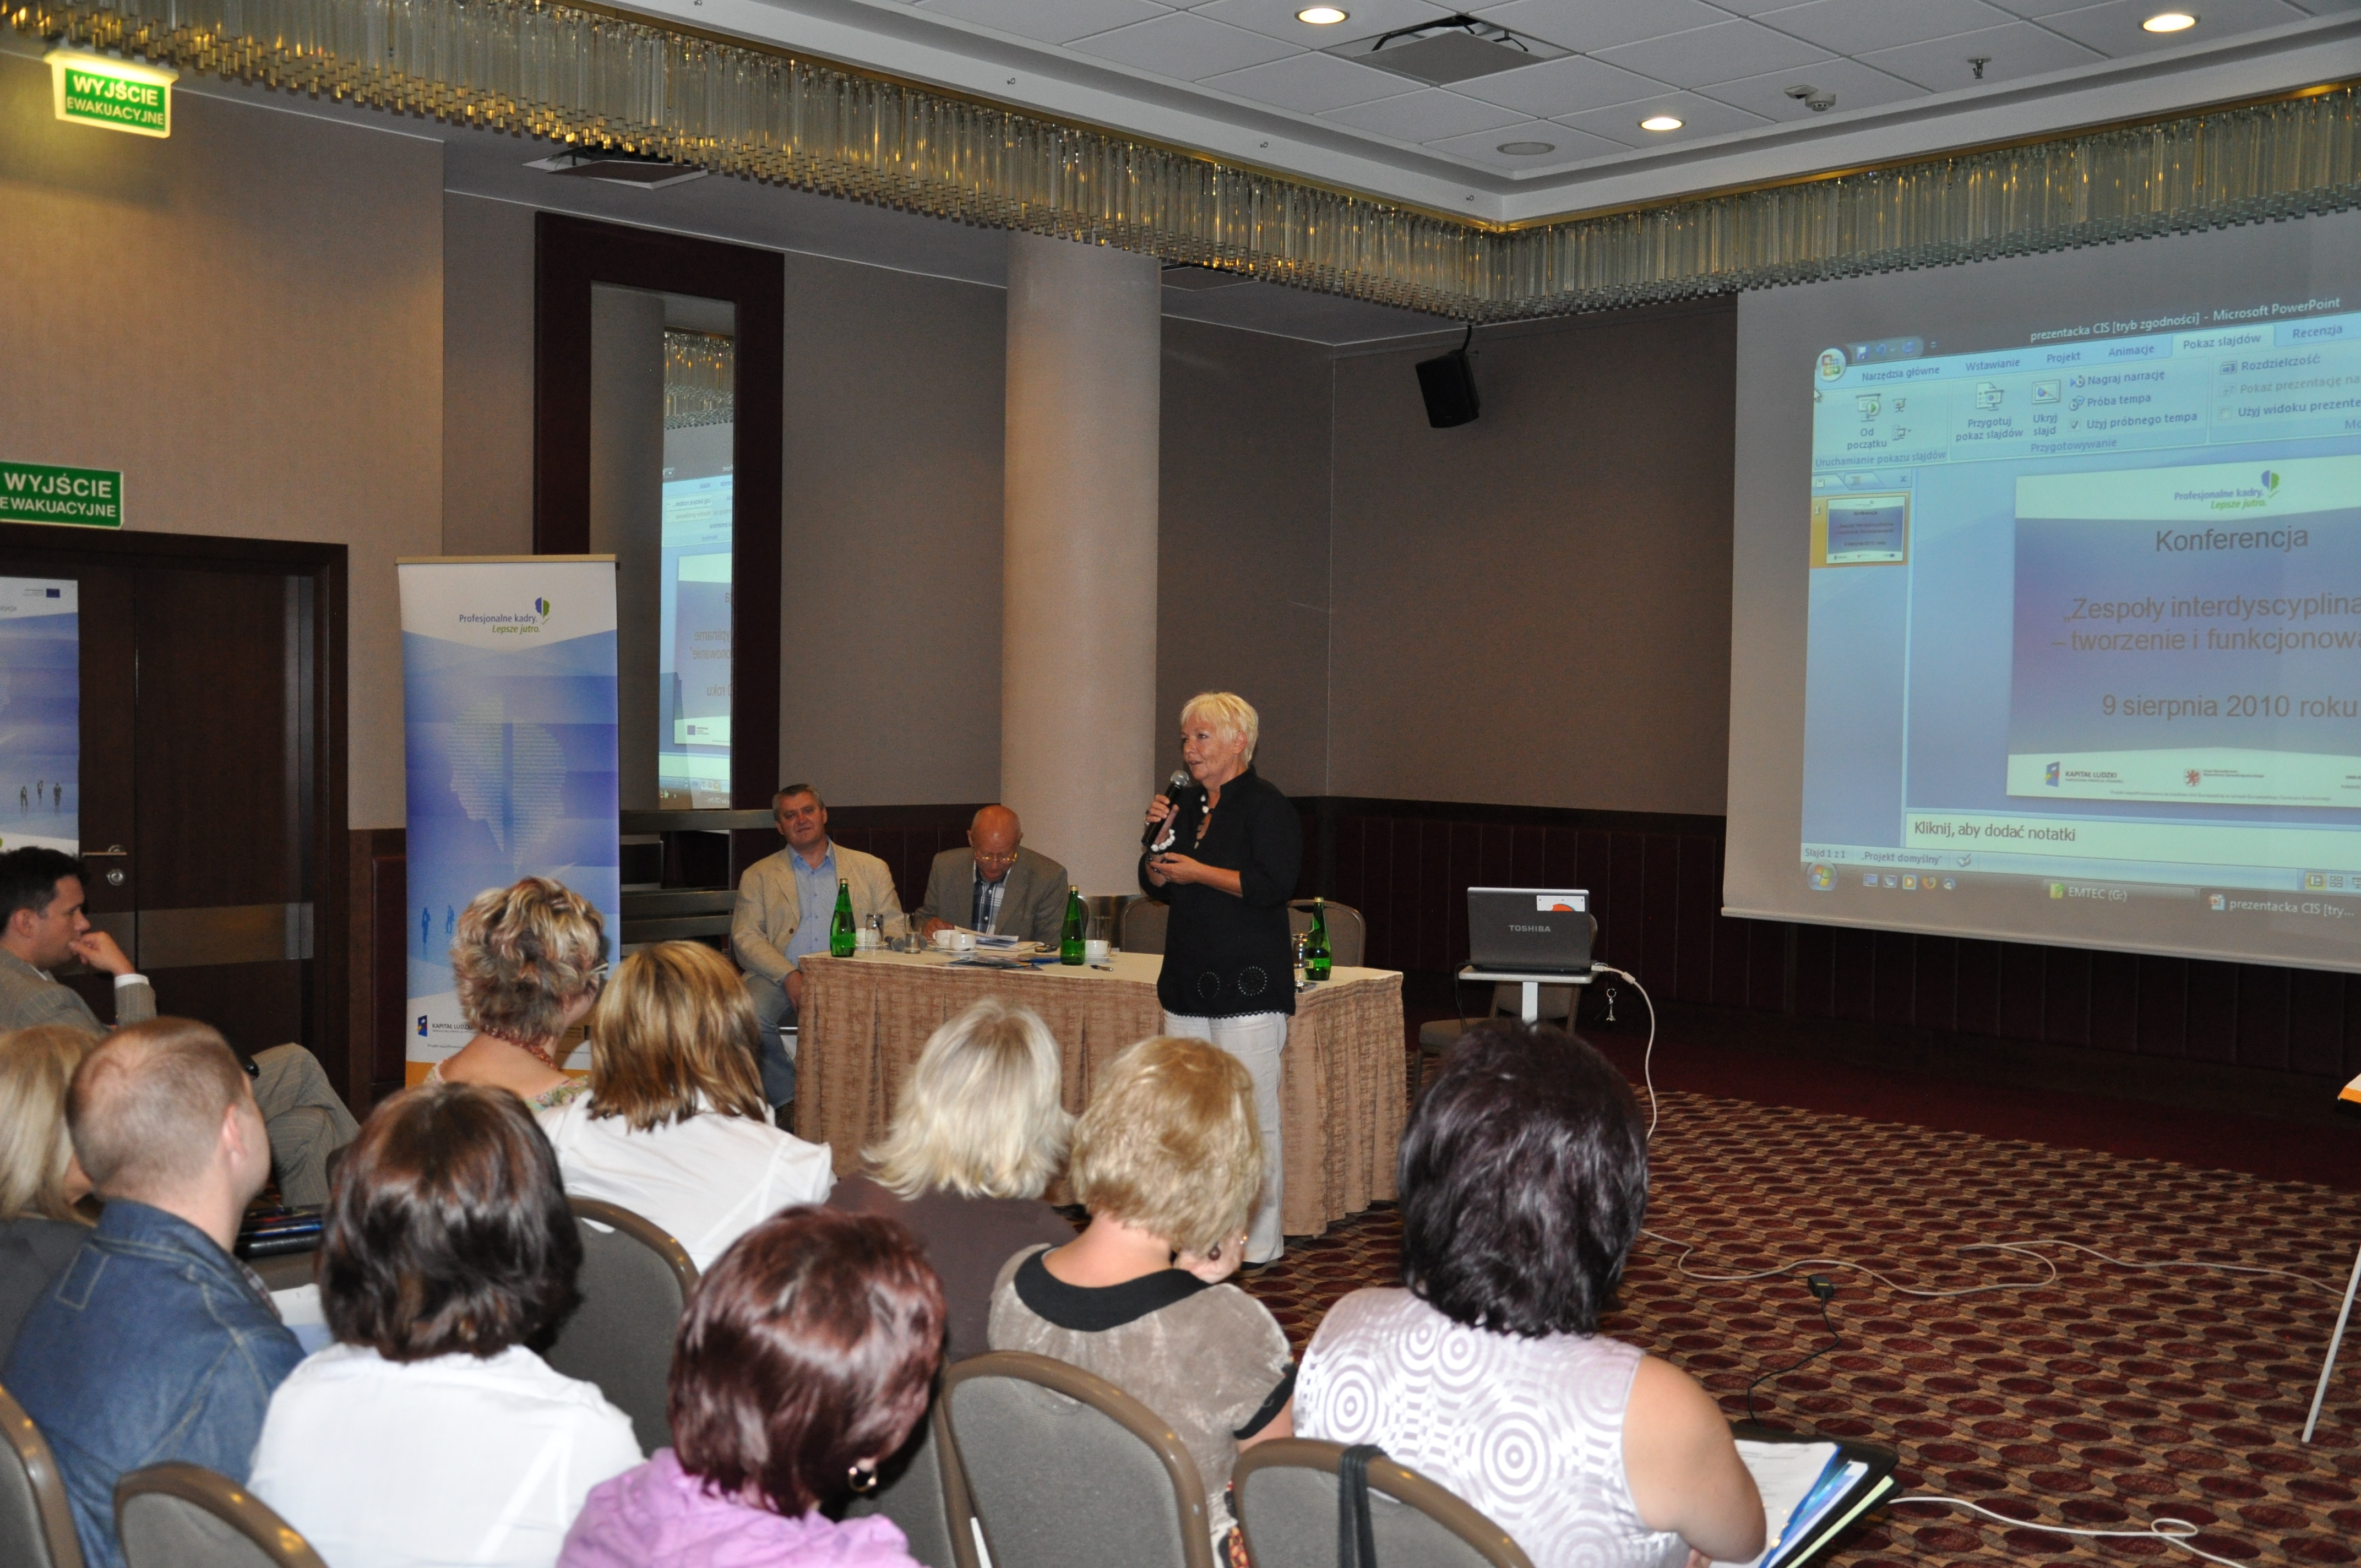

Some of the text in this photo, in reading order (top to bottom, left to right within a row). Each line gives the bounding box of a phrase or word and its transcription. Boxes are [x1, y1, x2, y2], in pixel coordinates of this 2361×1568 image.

[73, 75, 159, 106] WYJŚCIE
[67, 96, 164, 125] EWAKUACYJNE
[2031, 326, 2090, 343] prezentacka
[2093, 323, 2110, 334] CIS
[2213, 306, 2268, 321] Microsoft
[2272, 297, 2341, 314] PowerPoint
[2293, 325, 2343, 339] Recenzja
[2183, 334, 2261, 349] Pokaz slajdów
[2047, 352, 2081, 363] Projekt
[2108, 344, 2155, 357] Animacje
[1966, 358, 2020, 371] Wstawianie
[1862, 366, 1940, 381] Narzędzia główne
[2087, 370, 2165, 385] Nagraj narrację
[2276, 375, 2341, 392] prezentację
[2087, 394, 2151, 406] Próba tempa
[2238, 406, 2260, 417] Użyj
[2264, 403, 2306, 415] widoku
[1968, 416, 2011, 429] Przygotuj
[2033, 413, 2058, 424] Ukryj
[2087, 413, 2197, 429] Użyj próbnego tempa
[1860, 428, 1874, 436] Od
[1956, 428, 2023, 442] pokaz slajdów
[2033, 426, 2056, 437] slajd
[1847, 439, 1887, 451] początku
[2031, 439, 2117, 453] Przygotowywanie
[1815, 450, 1946, 467] Uruchamianie pokazu slajdów
[4, 472, 112, 498] WYJŚCIE
[2174, 488, 2264, 502] Profesjonalne kadry.
[0, 497, 116, 517] EWAKUACYJNE
[2211, 498, 2267, 510] Lepsze jutro.
[2156, 525, 2308, 553] Konferencja
[459, 613, 537, 624] Profesjonalne kadry.
[492, 624, 540, 635] Lepsze jutro.
[2071, 629, 2186, 651] tworzenie
[2193, 628, 2199, 650] i
[2102, 694, 2358, 721] 9 sierpnia 2010 roku
[1915, 821, 2075, 841] Kliknij, aby dodać notatki
[1804, 848, 1825, 859] Slajd
[2068, 886, 2105, 899] EMTEC
[2229, 900, 2298, 913] prezentacka
[2300, 902, 2321, 914] CIS
